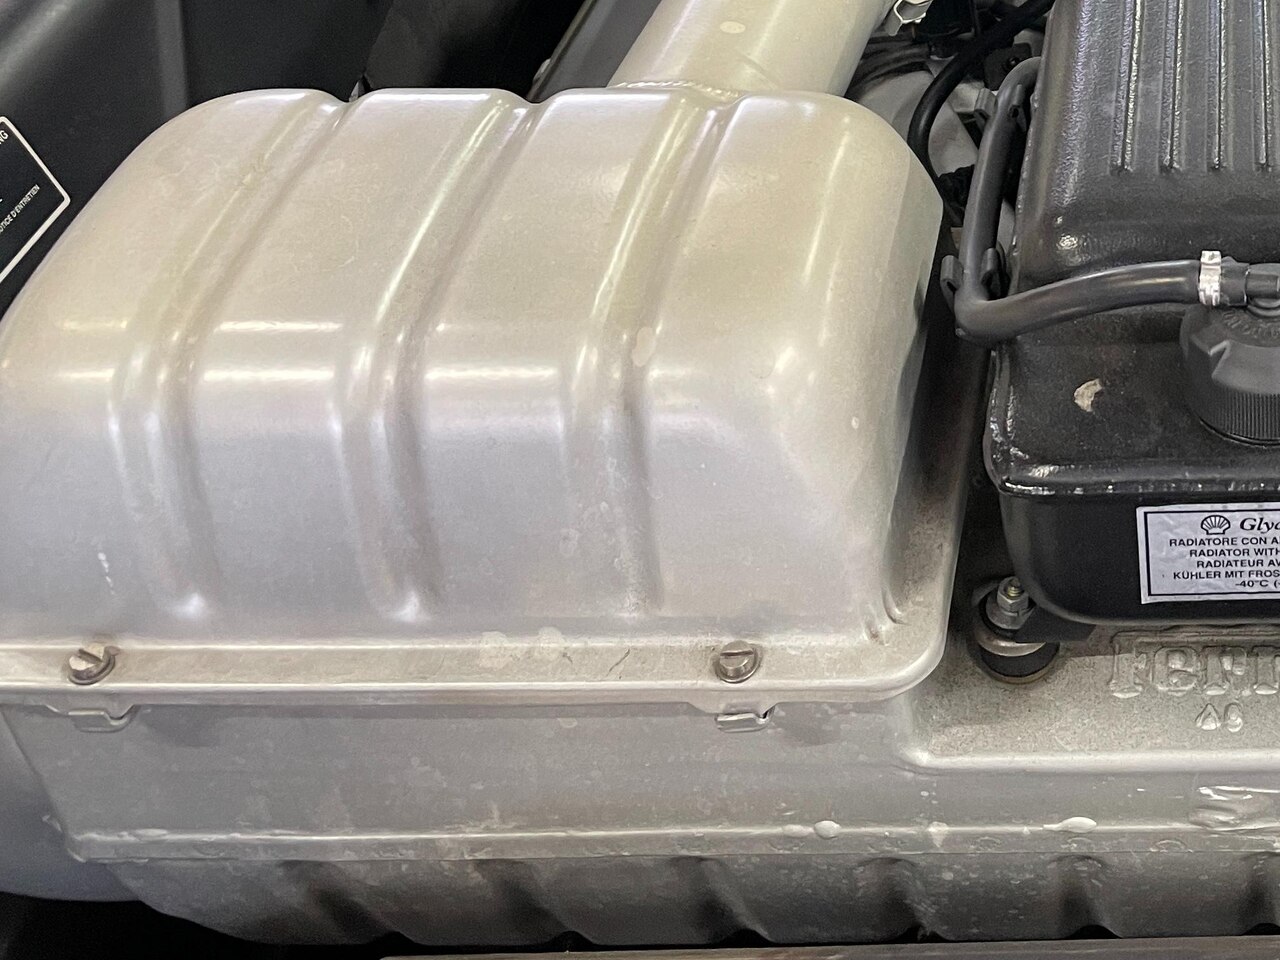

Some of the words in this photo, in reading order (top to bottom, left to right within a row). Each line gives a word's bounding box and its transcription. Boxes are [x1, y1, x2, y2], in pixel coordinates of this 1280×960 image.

[1169, 536, 1238, 547] RADIATORE
[1241, 536, 1268, 546] CON
[1189, 548, 1250, 558] RADIATOR
[1196, 559, 1264, 569] RADIATEUR
[1173, 569, 1222, 580] KÜHLER
[1224, 570, 1245, 579] MIT
